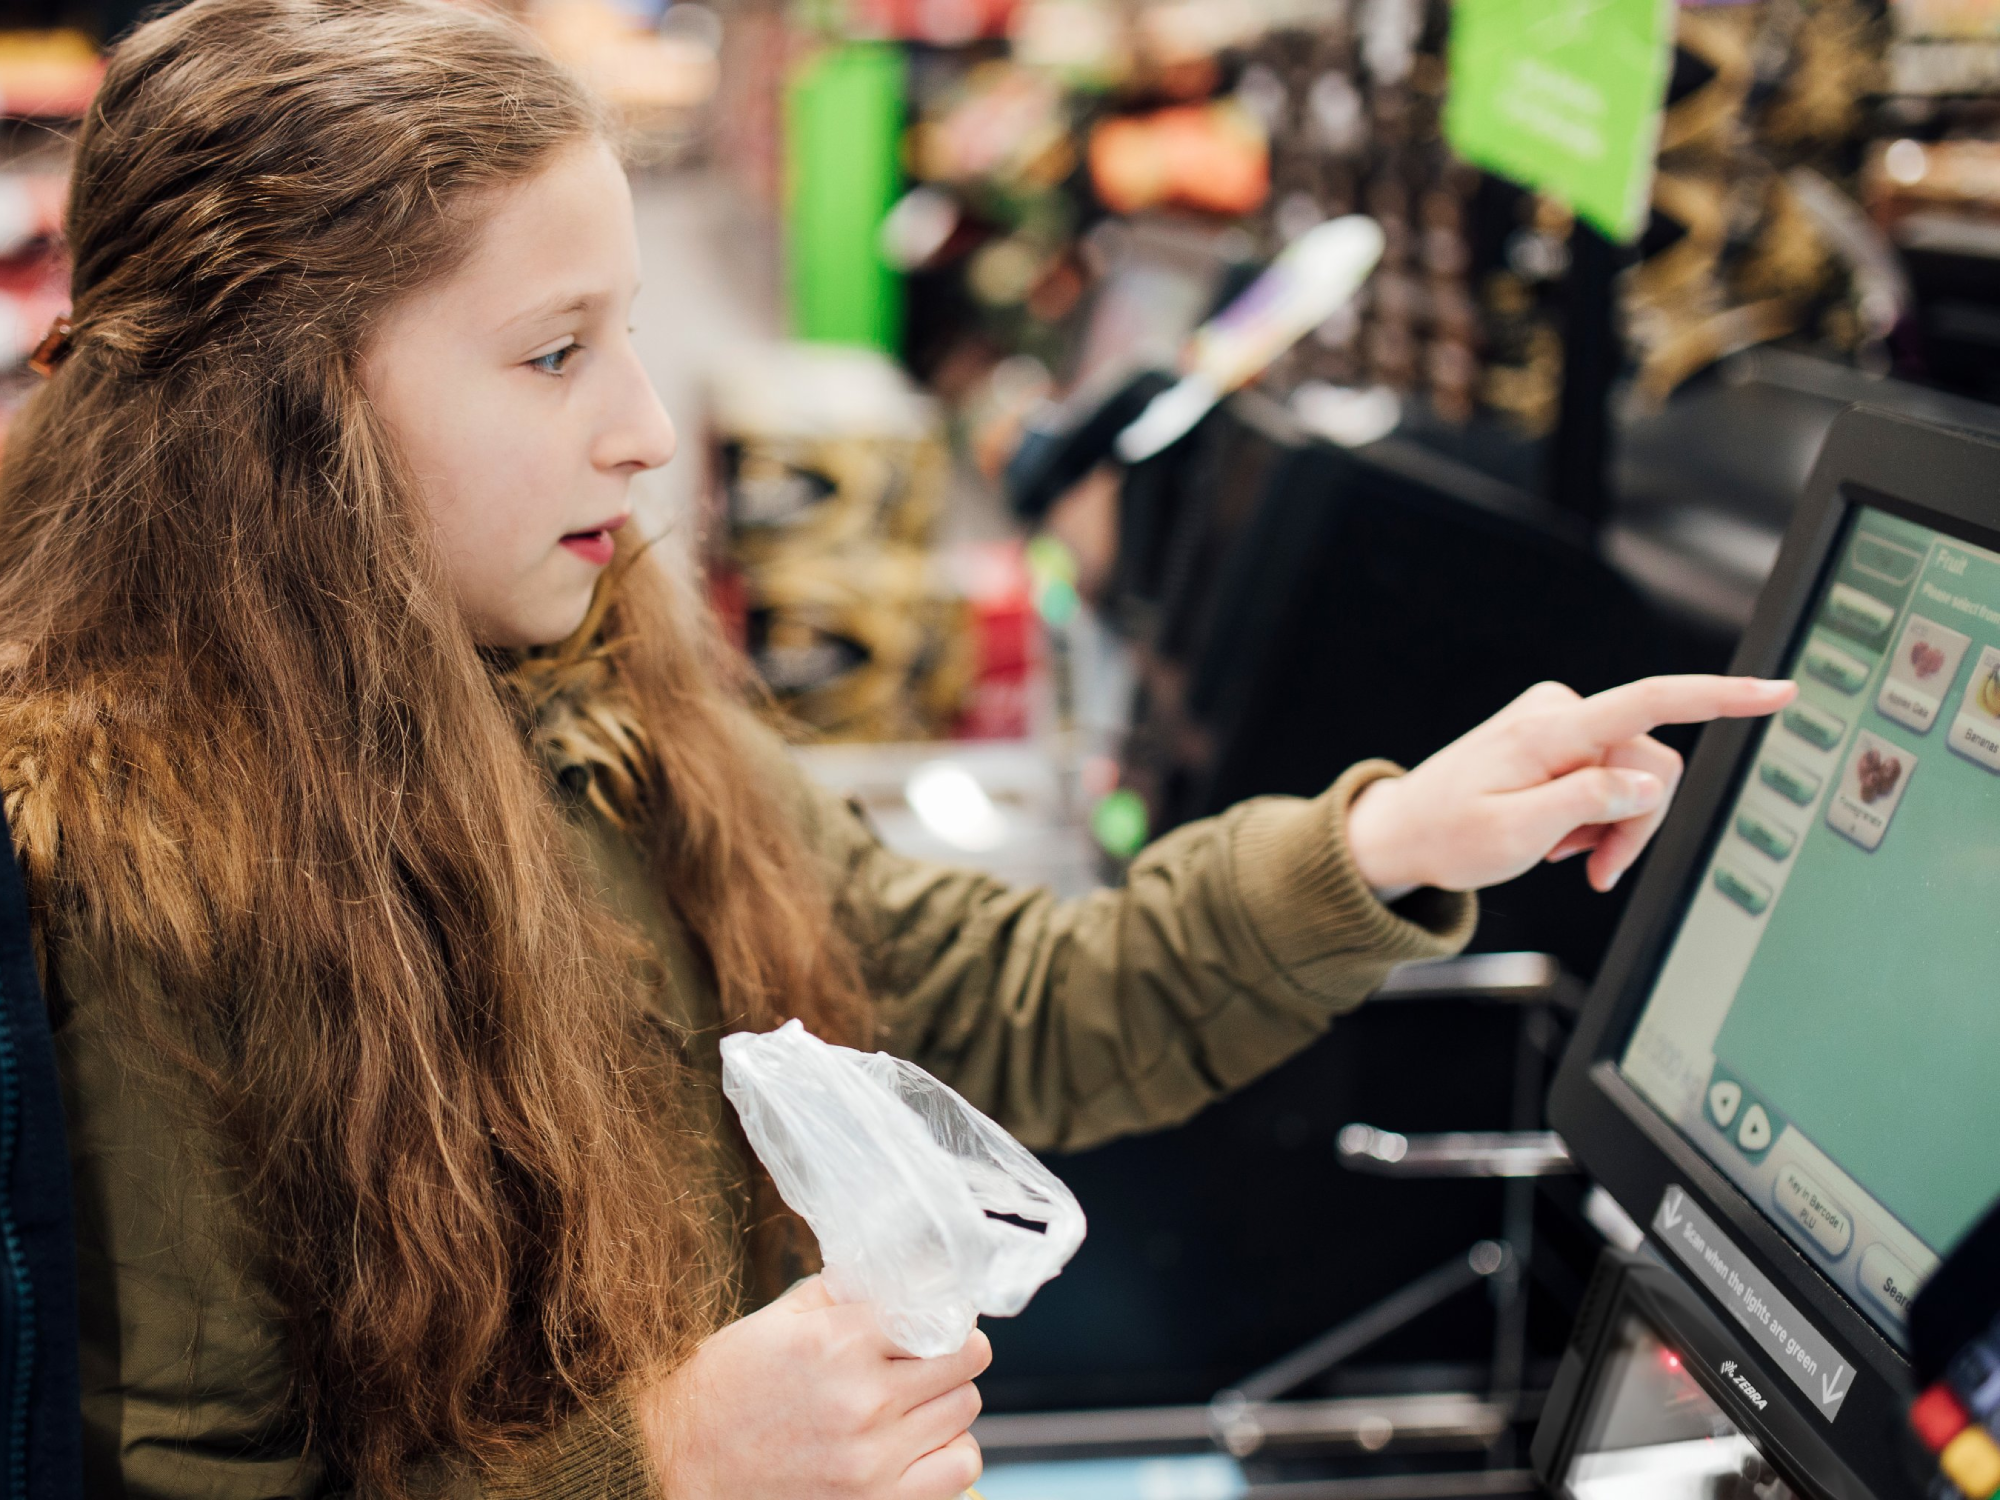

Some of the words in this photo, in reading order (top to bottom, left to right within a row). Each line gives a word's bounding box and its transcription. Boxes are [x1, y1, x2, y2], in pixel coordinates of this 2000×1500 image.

[1936, 549, 1968, 575] Fruit
[1965, 727, 1999, 753] Bananas
[1788, 1174, 1801, 1195] Key
[1809, 1192, 1840, 1228] Barcode
[1800, 1208, 1817, 1230] PLU
[1683, 1221, 1706, 1252] Scan
[1704, 1247, 1729, 1280] when
[1728, 1270, 1745, 1296] the
[1743, 1287, 1771, 1325] lights
[1769, 1319, 1787, 1343] are
[1785, 1337, 1818, 1377] green
[1883, 1276, 1912, 1313] Searc
[1732, 1374, 1768, 1410] ZEBRA
